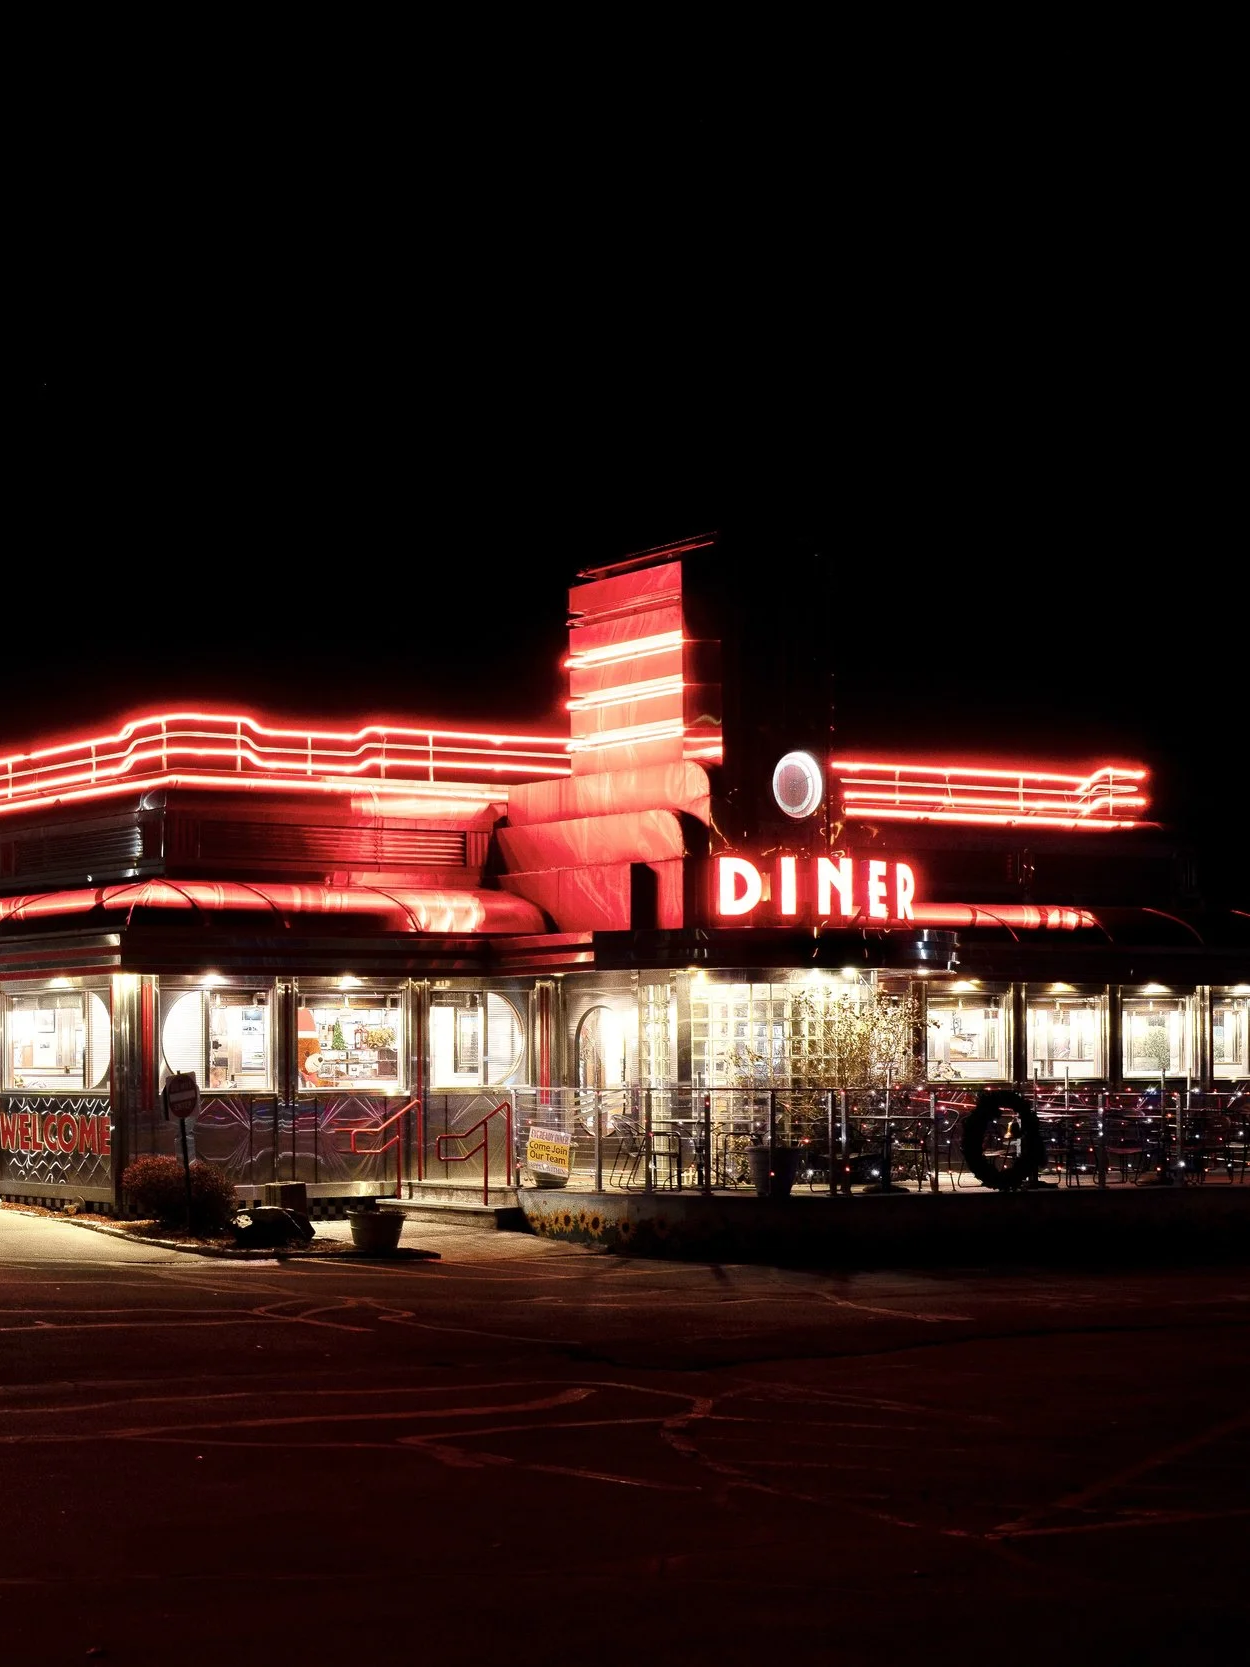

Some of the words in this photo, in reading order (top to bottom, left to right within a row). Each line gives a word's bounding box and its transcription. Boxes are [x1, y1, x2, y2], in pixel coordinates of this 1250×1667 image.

[718, 856, 916, 920] DINER
[0, 1112, 111, 1156] WELCOME
[529, 1140, 551, 1152] Come
[551, 1145, 568, 1156] Join
[529, 1150, 544, 1160] Our
[545, 1153, 566, 1165] Team
